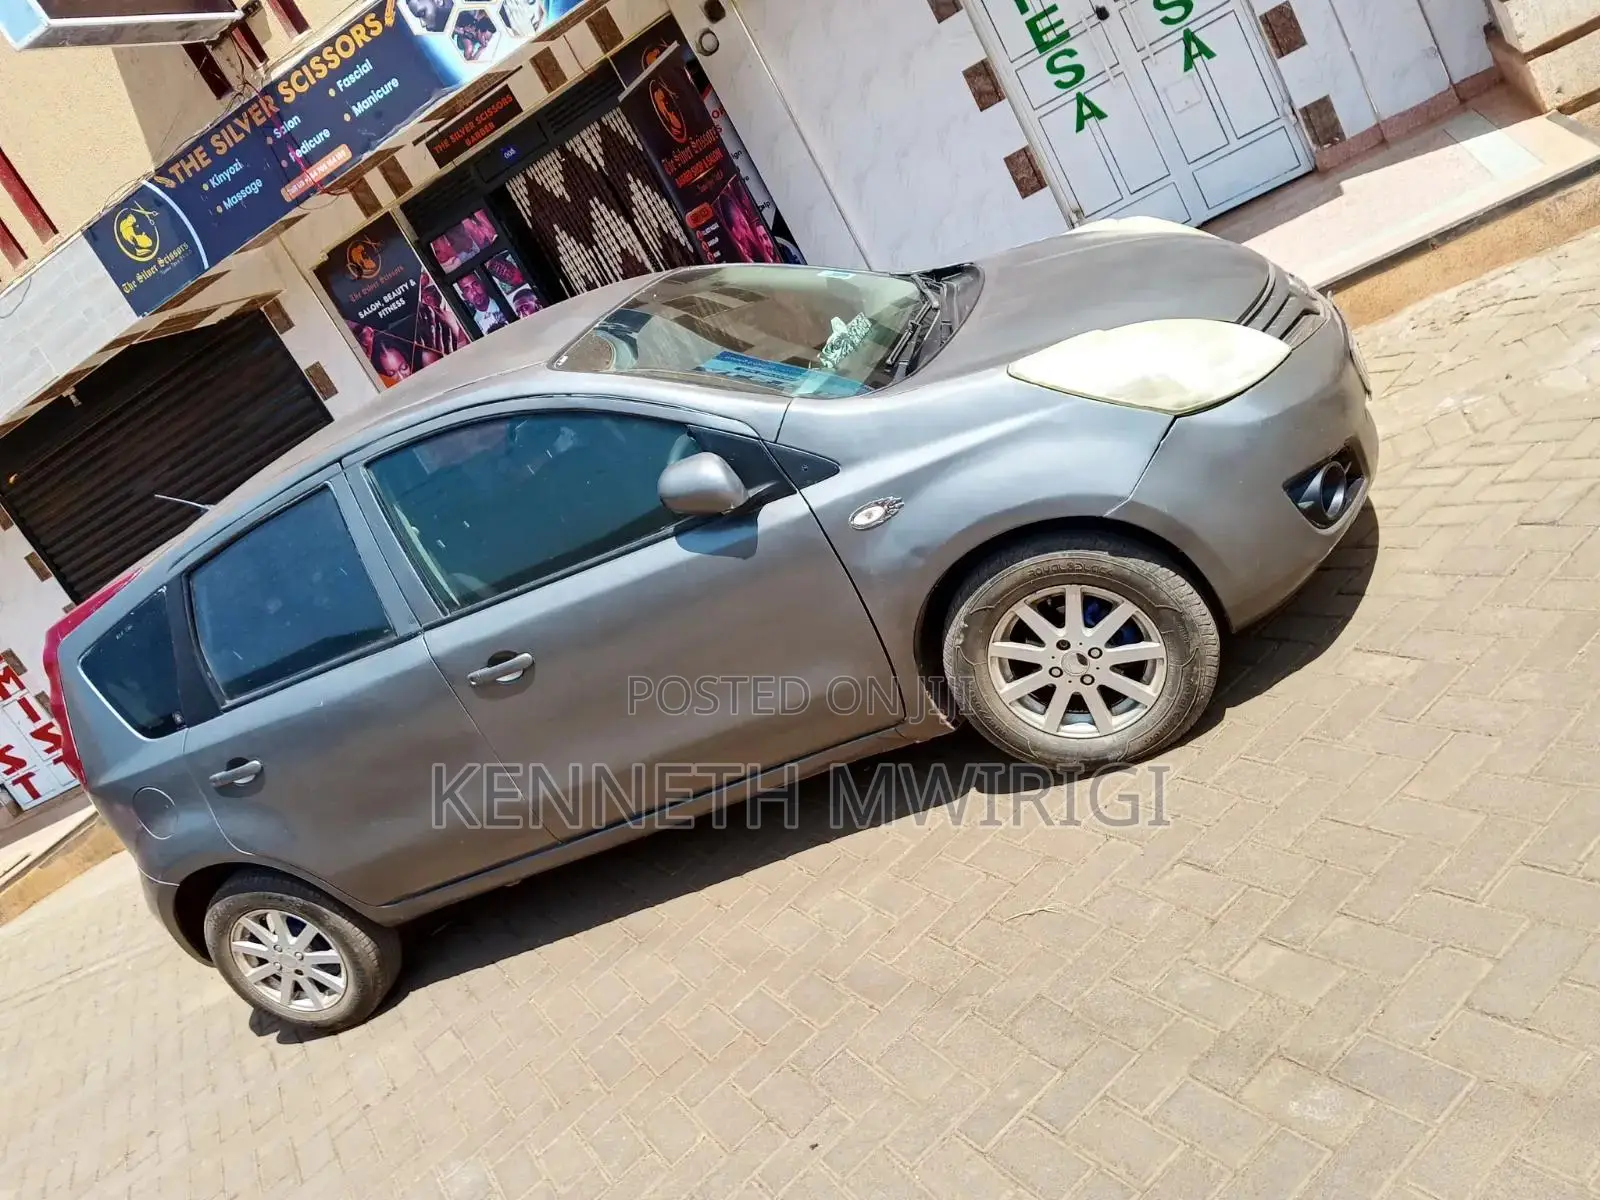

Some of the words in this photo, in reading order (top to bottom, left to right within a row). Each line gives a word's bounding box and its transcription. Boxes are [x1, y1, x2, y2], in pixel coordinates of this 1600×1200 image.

[336, 58, 373, 92] Fascial
[1014, 0, 1108, 134] ESA
[168, 145, 212, 184] THE
[210, 95, 280, 155] SILVER
[277, 12, 383, 104] SCISSORS
[351, 77, 399, 117] Manicure
[273, 115, 301, 139] Salon
[431, 138, 450, 153] THE
[449, 121, 475, 143] SILVER
[474, 94, 513, 124] SCISSORS
[209, 158, 243, 188] Kinyozi
[222, 178, 263, 210] Massage
[121, 280, 137, 293] The
[136, 265, 158, 283] Silver
[358, 300, 385, 319] SALON,
[382, 282, 409, 303] BEAUTY
[409, 279, 417, 287] &
[377, 297, 406, 319] FITNESS
